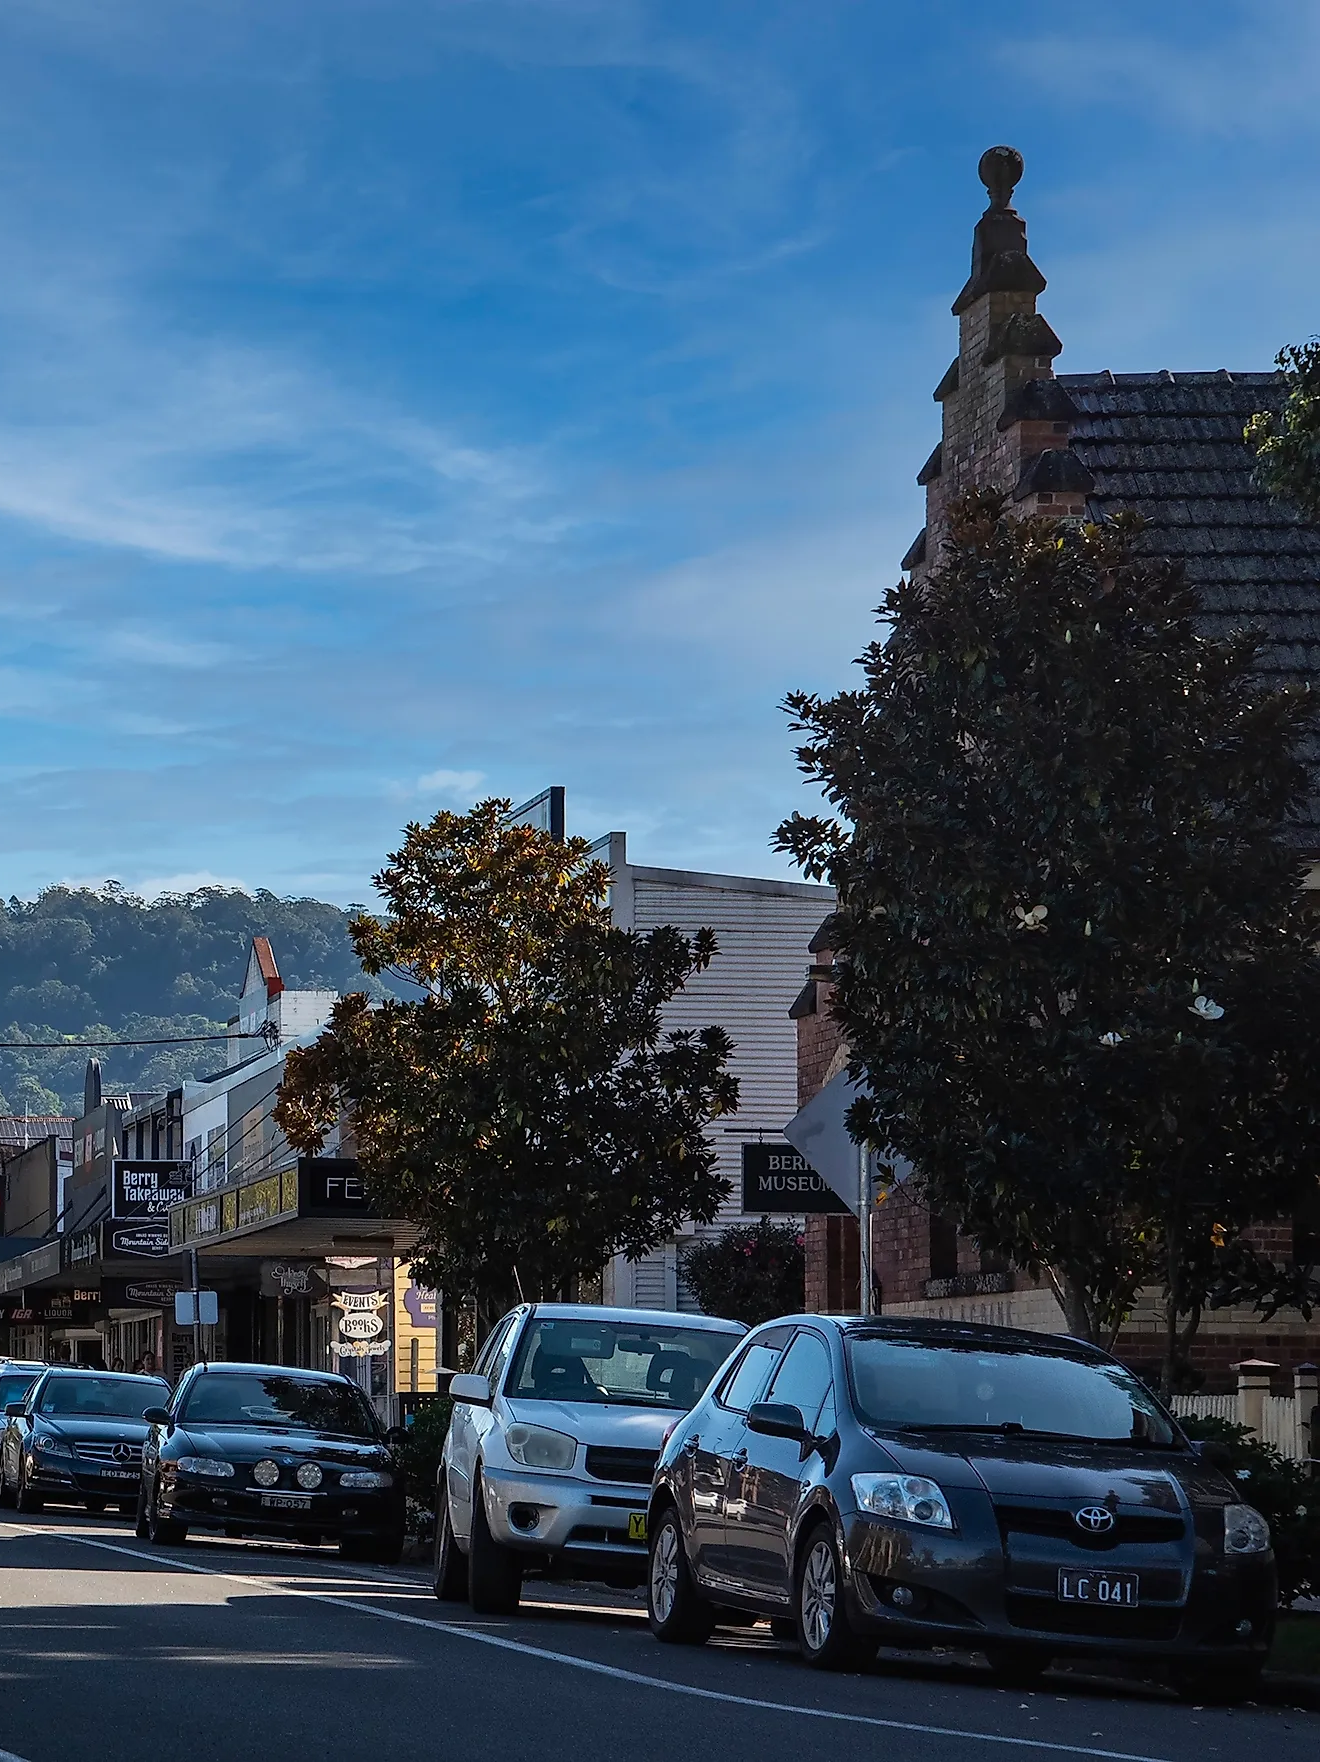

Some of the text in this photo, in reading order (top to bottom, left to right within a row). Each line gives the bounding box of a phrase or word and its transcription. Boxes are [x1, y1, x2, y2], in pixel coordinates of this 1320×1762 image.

[768, 1155, 814, 1171] BER
[123, 1170, 158, 1188] Berry
[123, 1186, 185, 1202] Takeaway
[120, 1237, 154, 1246] Mountain
[73, 1289, 99, 1301] Berr
[128, 1287, 165, 1297] Mountain
[416, 1291, 437, 1300] Heal
[342, 1294, 379, 1308] EVENTS
[11, 1309, 33, 1319] IGA
[44, 1309, 73, 1318] LIQUOR
[1098, 1580, 1131, 1603] 041
